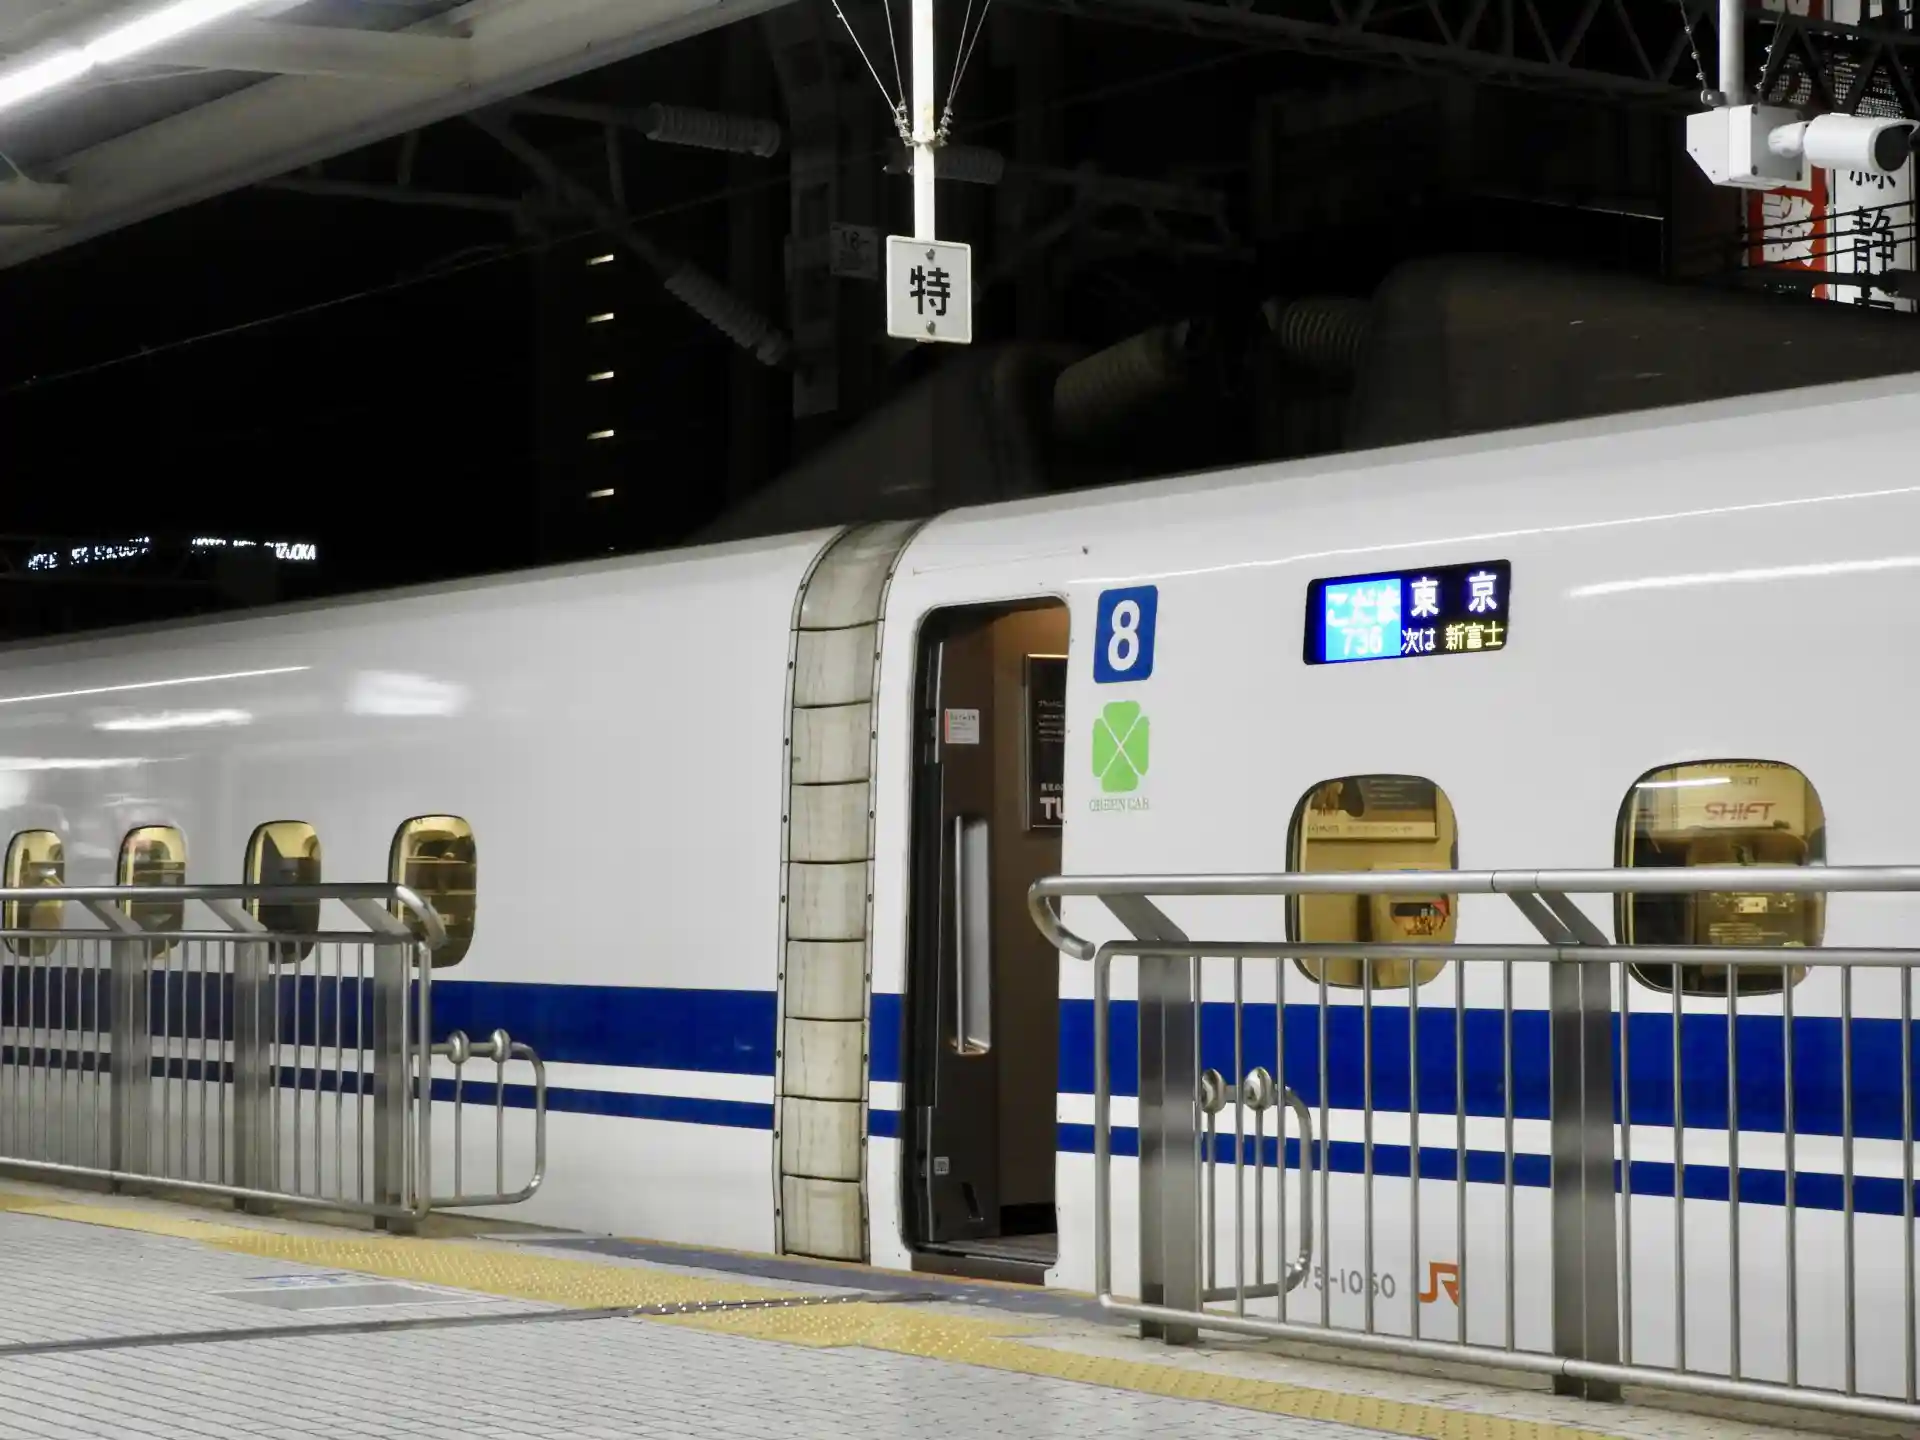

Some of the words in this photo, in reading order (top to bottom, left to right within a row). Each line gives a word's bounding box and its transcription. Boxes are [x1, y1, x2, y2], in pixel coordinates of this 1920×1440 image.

[909, 265, 951, 316] 特
[1410, 570, 1498, 618] 東京
[1107, 599, 1141, 672] 8
[1400, 626, 1436, 654] 次は
[1445, 620, 1504, 651] 新富士
[1089, 798, 1127, 812] GREEN
[1128, 796, 1150, 811] CAR
[1705, 802, 1776, 821] SHIFT
